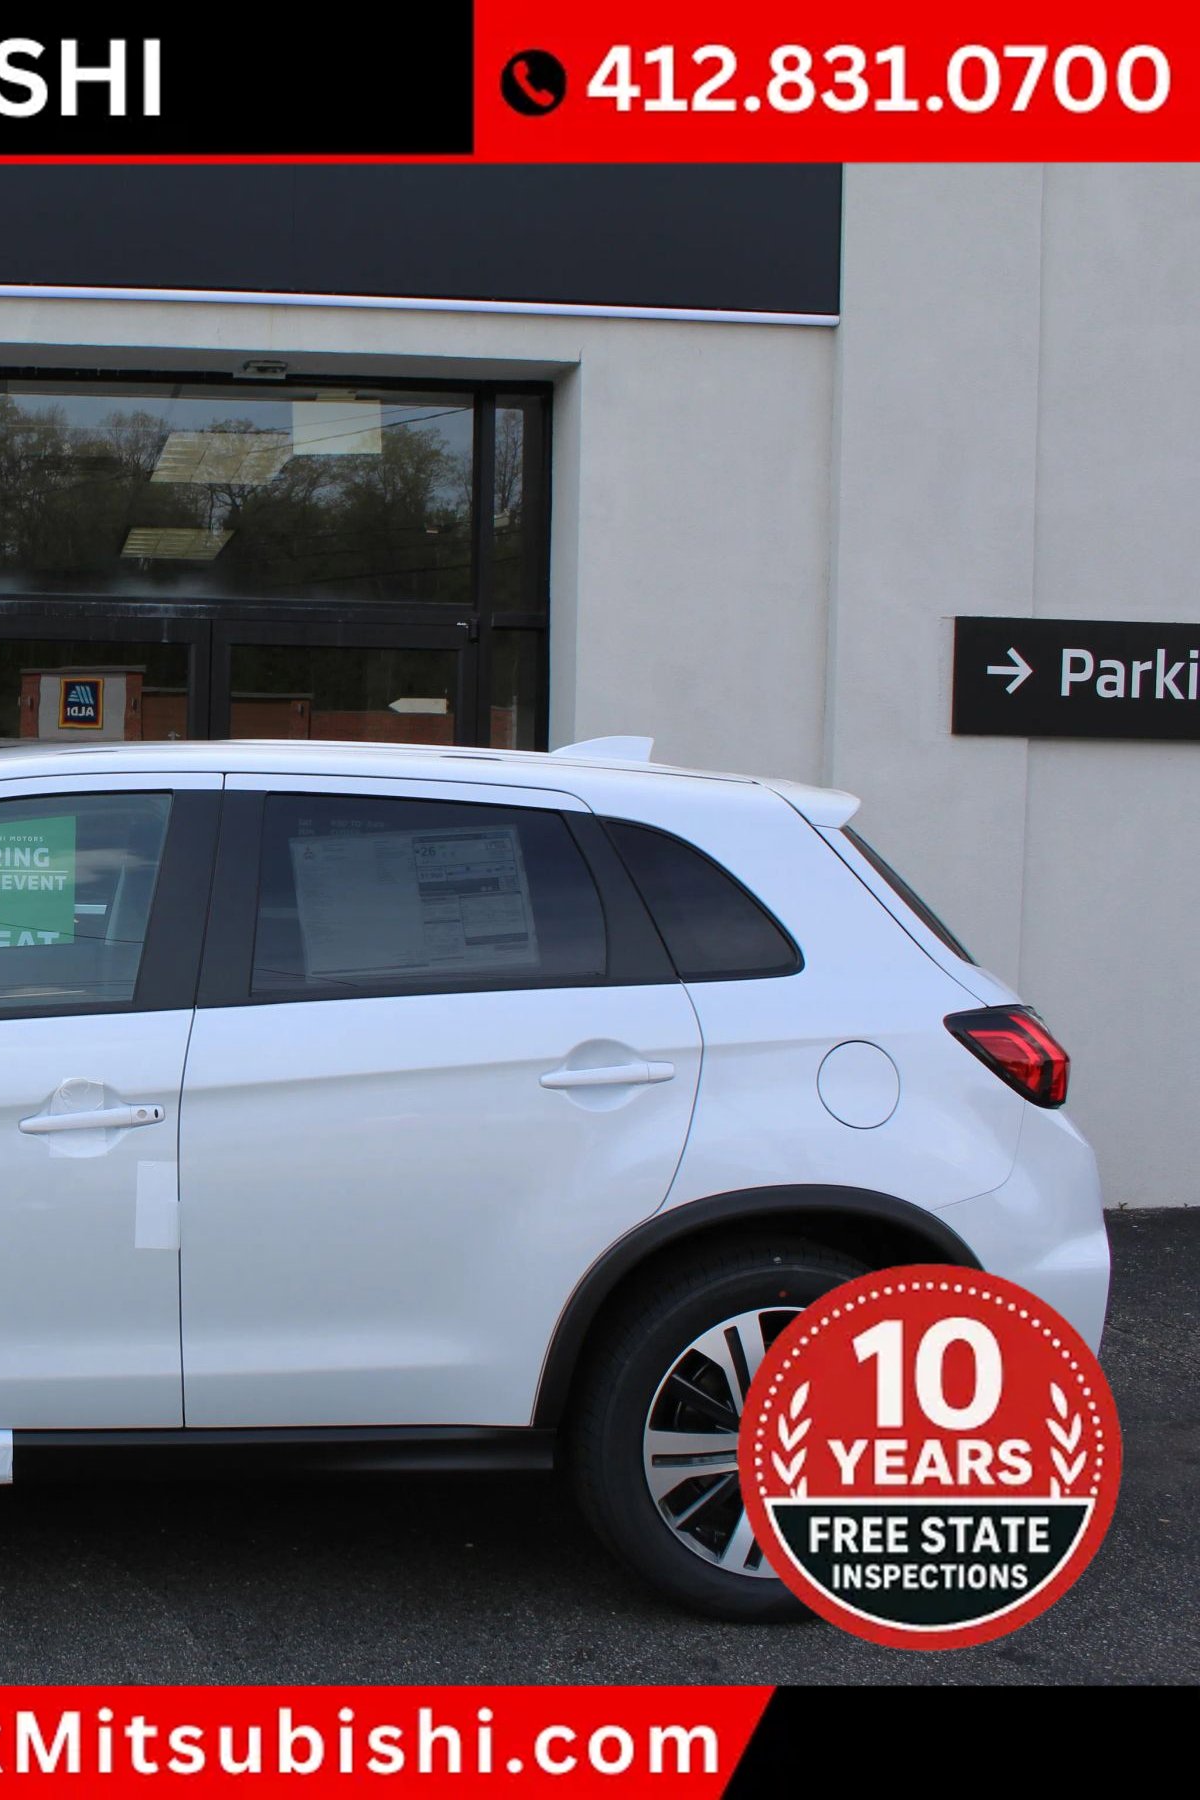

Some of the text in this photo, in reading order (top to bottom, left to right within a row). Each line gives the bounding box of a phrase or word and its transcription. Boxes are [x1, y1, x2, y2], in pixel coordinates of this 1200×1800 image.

[1060, 648, 1200, 700] Parki
[9, 835, 44, 843] MOTORS
[1, 874, 68, 891] EVENT
